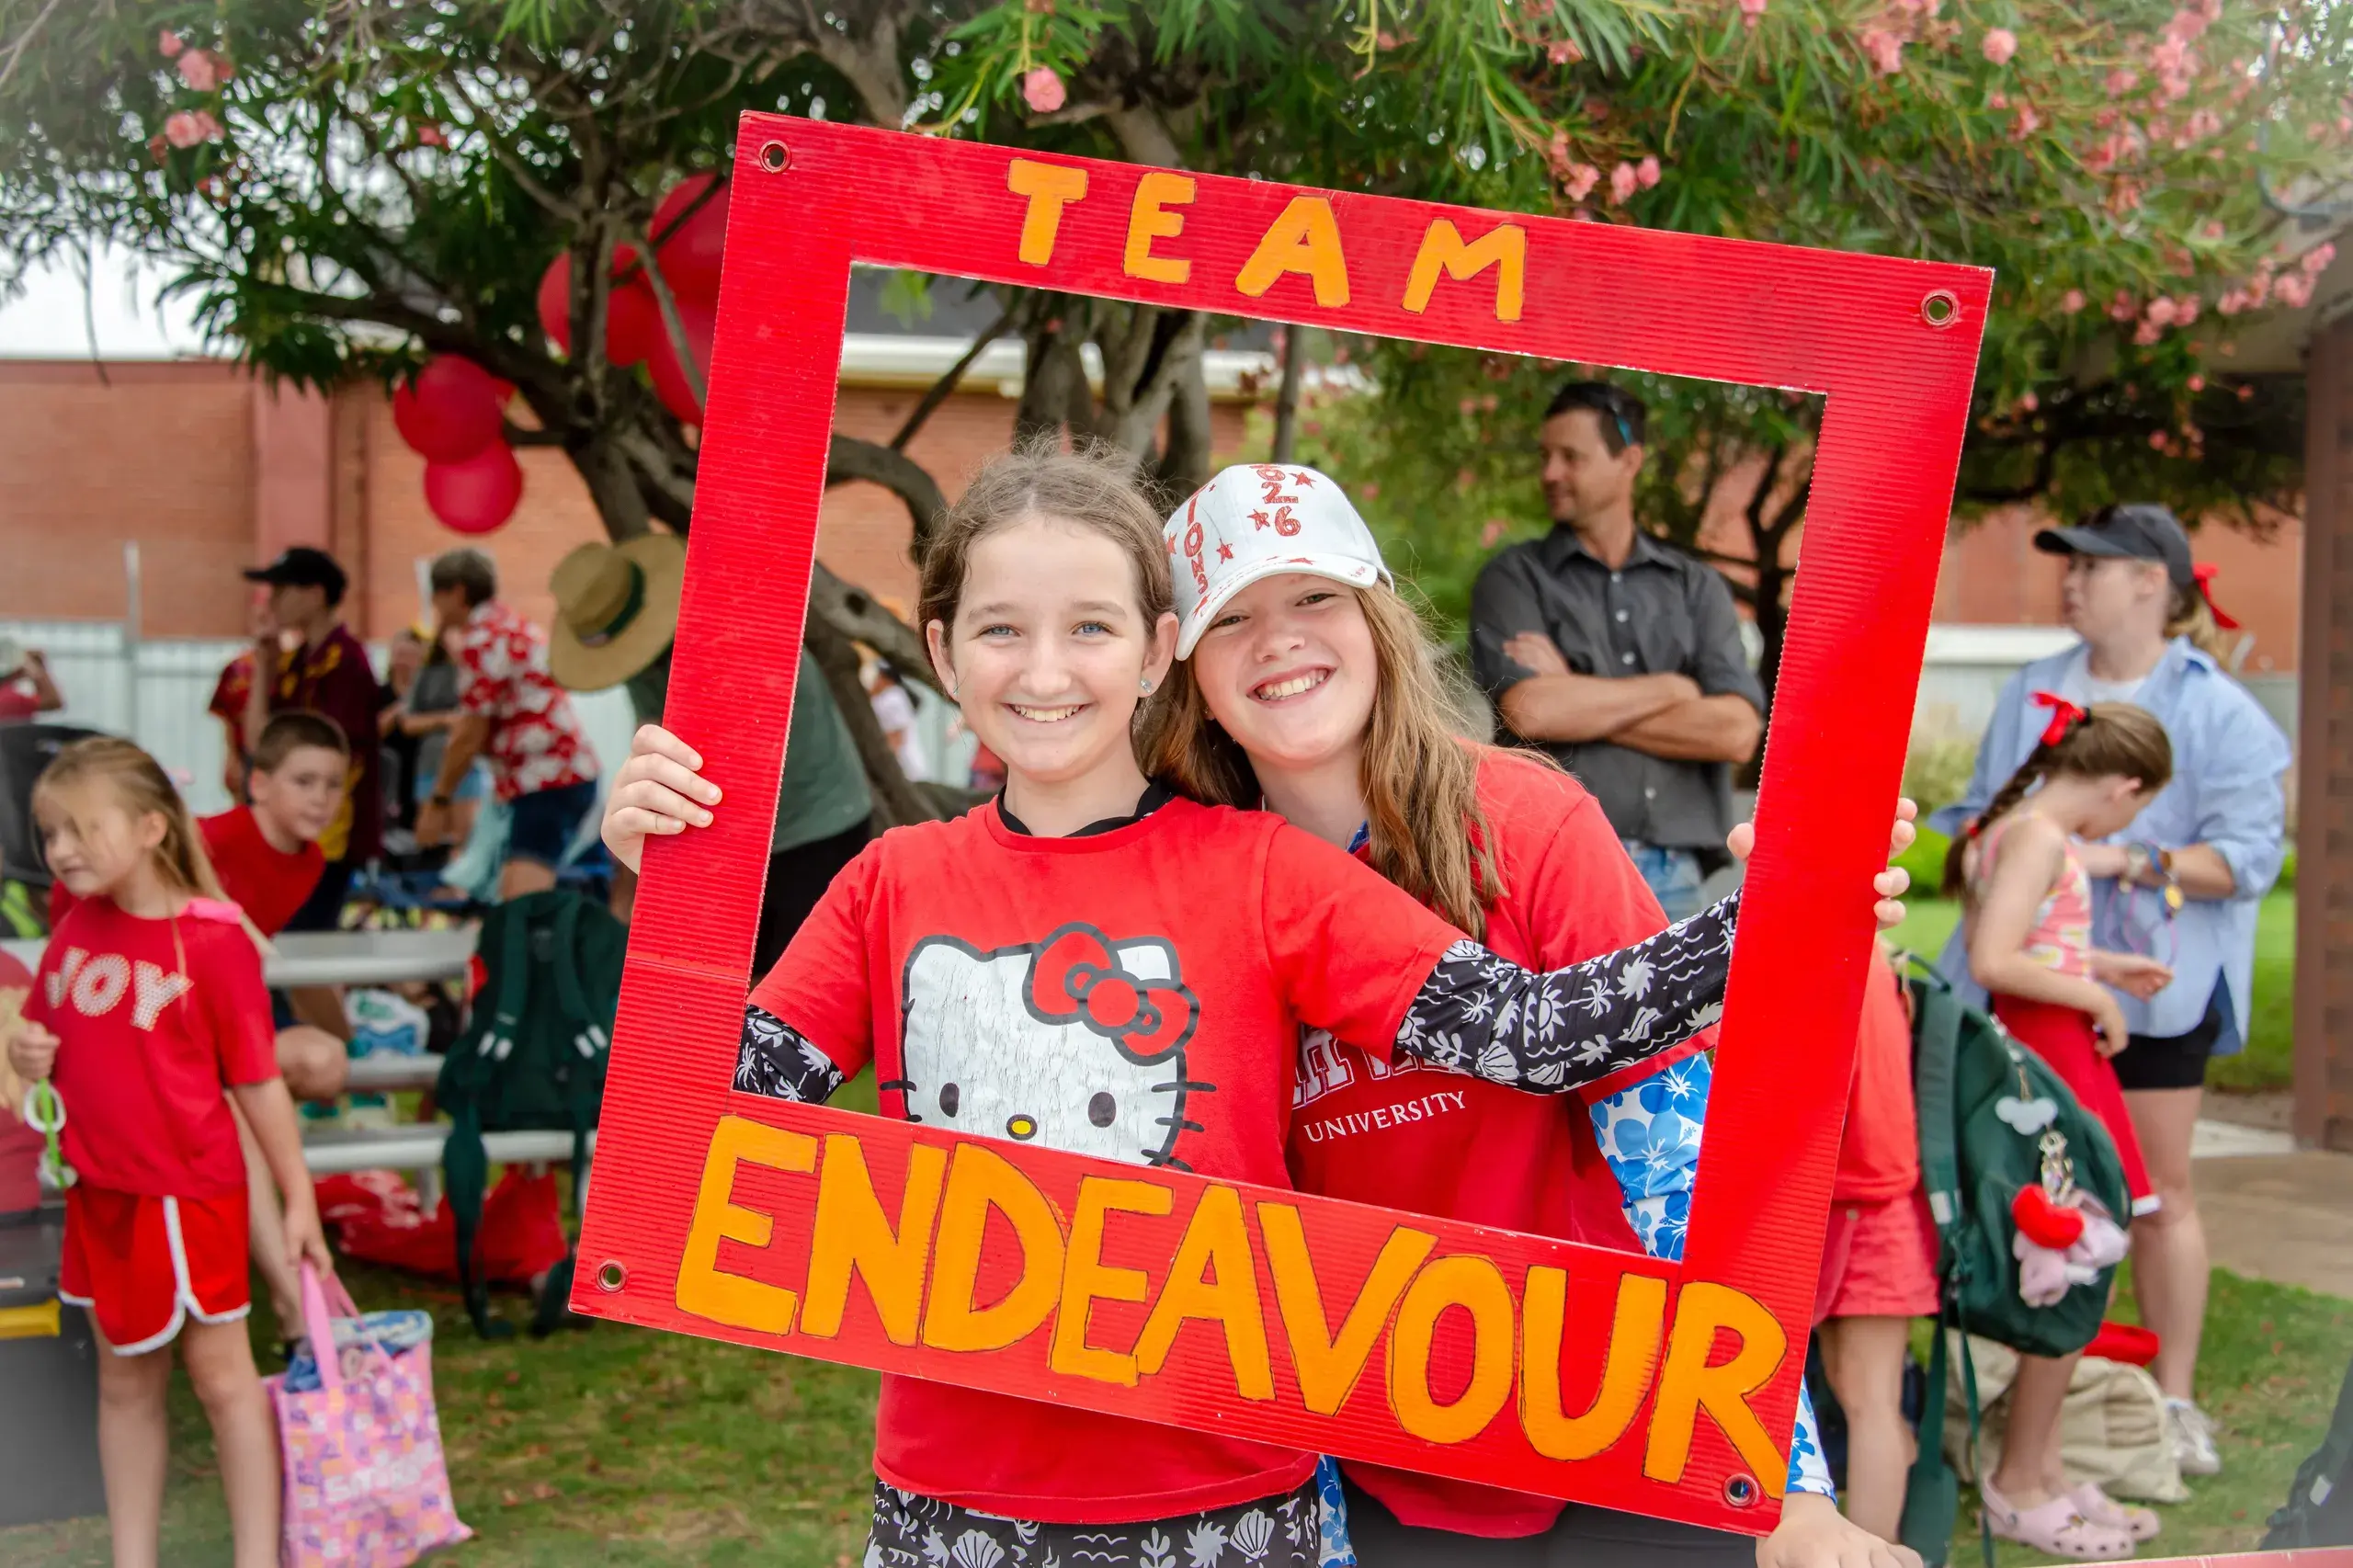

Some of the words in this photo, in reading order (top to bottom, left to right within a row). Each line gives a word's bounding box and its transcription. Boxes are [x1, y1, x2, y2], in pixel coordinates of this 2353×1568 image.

[1007, 157, 1528, 323] TEAM
[46, 946, 194, 1031] JOY
[1303, 1091, 1466, 1142] UNIVERSITY
[675, 1114, 1789, 1499] ENDEAVOUR
